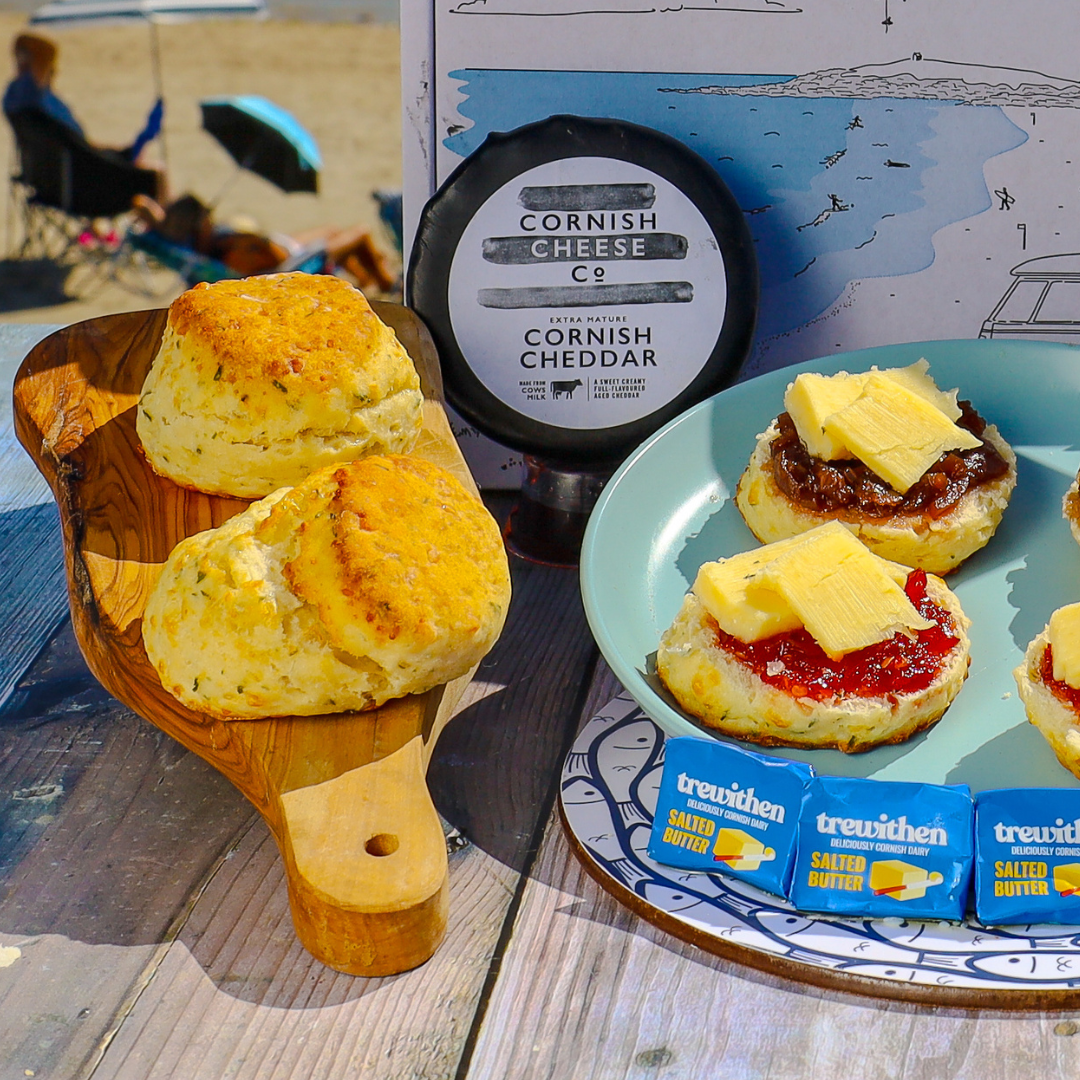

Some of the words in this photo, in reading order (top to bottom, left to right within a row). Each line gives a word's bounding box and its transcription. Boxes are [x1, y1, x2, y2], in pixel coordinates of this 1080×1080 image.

[520, 212, 656, 231] CORNISH
[530, 238, 646, 258] CHEESE
[550, 316, 582, 324] EXTRA
[524, 326, 651, 346] CORNISH
[520, 349, 658, 369] CHEDDAR
[677, 772, 786, 824] trewithen
[668, 808, 716, 836] SALTED
[687, 798, 724, 817] DELICIOUSLY
[724, 810, 751, 826] CORNISH
[751, 818, 770, 832] DAIRY
[816, 812, 948, 846] trewithen
[662, 827, 710, 854] BUTTER
[830, 838, 874, 851] DELICIOUSLY
[876, 842, 906, 854] CORNISH
[908, 846, 930, 856] DAIRY
[1012, 846, 1054, 856] DELICIOUSLY
[811, 851, 866, 872] SALTED
[994, 860, 1048, 878] SALTED
[808, 870, 864, 892] BUTTER
[994, 880, 1050, 897] BUTTER
